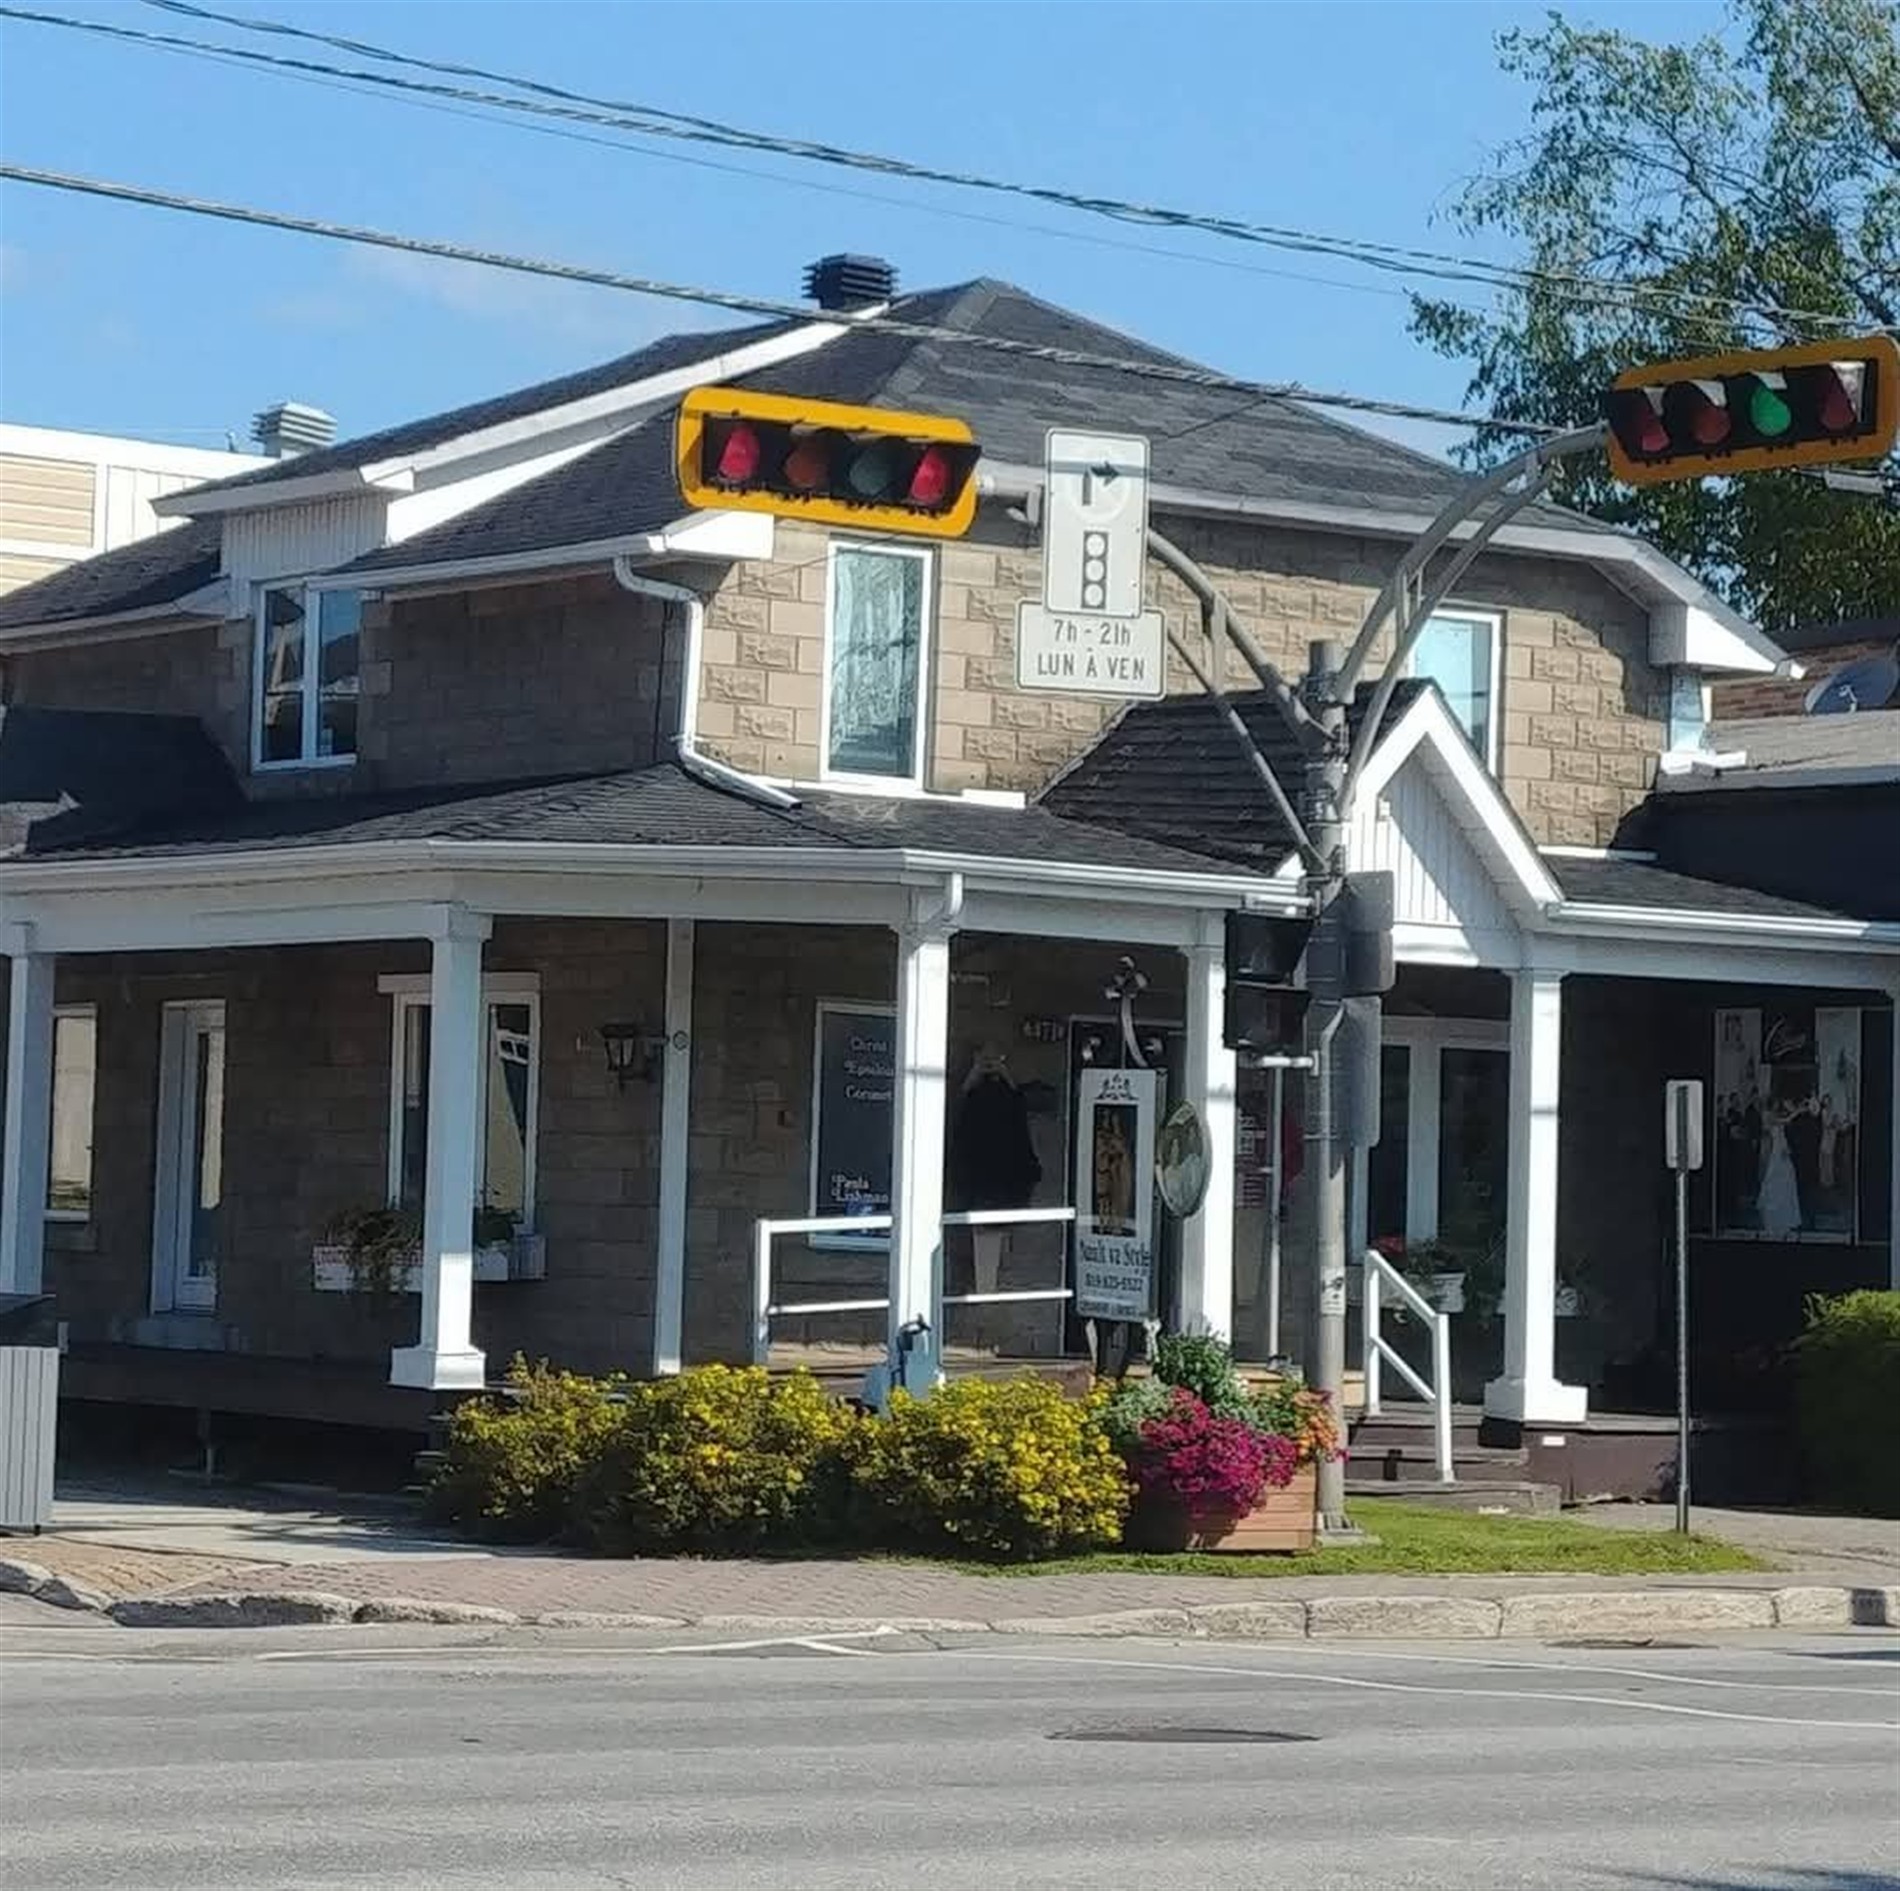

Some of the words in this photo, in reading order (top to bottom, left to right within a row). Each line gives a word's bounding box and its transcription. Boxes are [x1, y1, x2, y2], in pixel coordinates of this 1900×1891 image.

[1053, 618, 1077, 643] 7h
[1099, 621, 1131, 646] 21h
[1037, 652, 1075, 677] LUN
[1106, 656, 1145, 681] VEN
